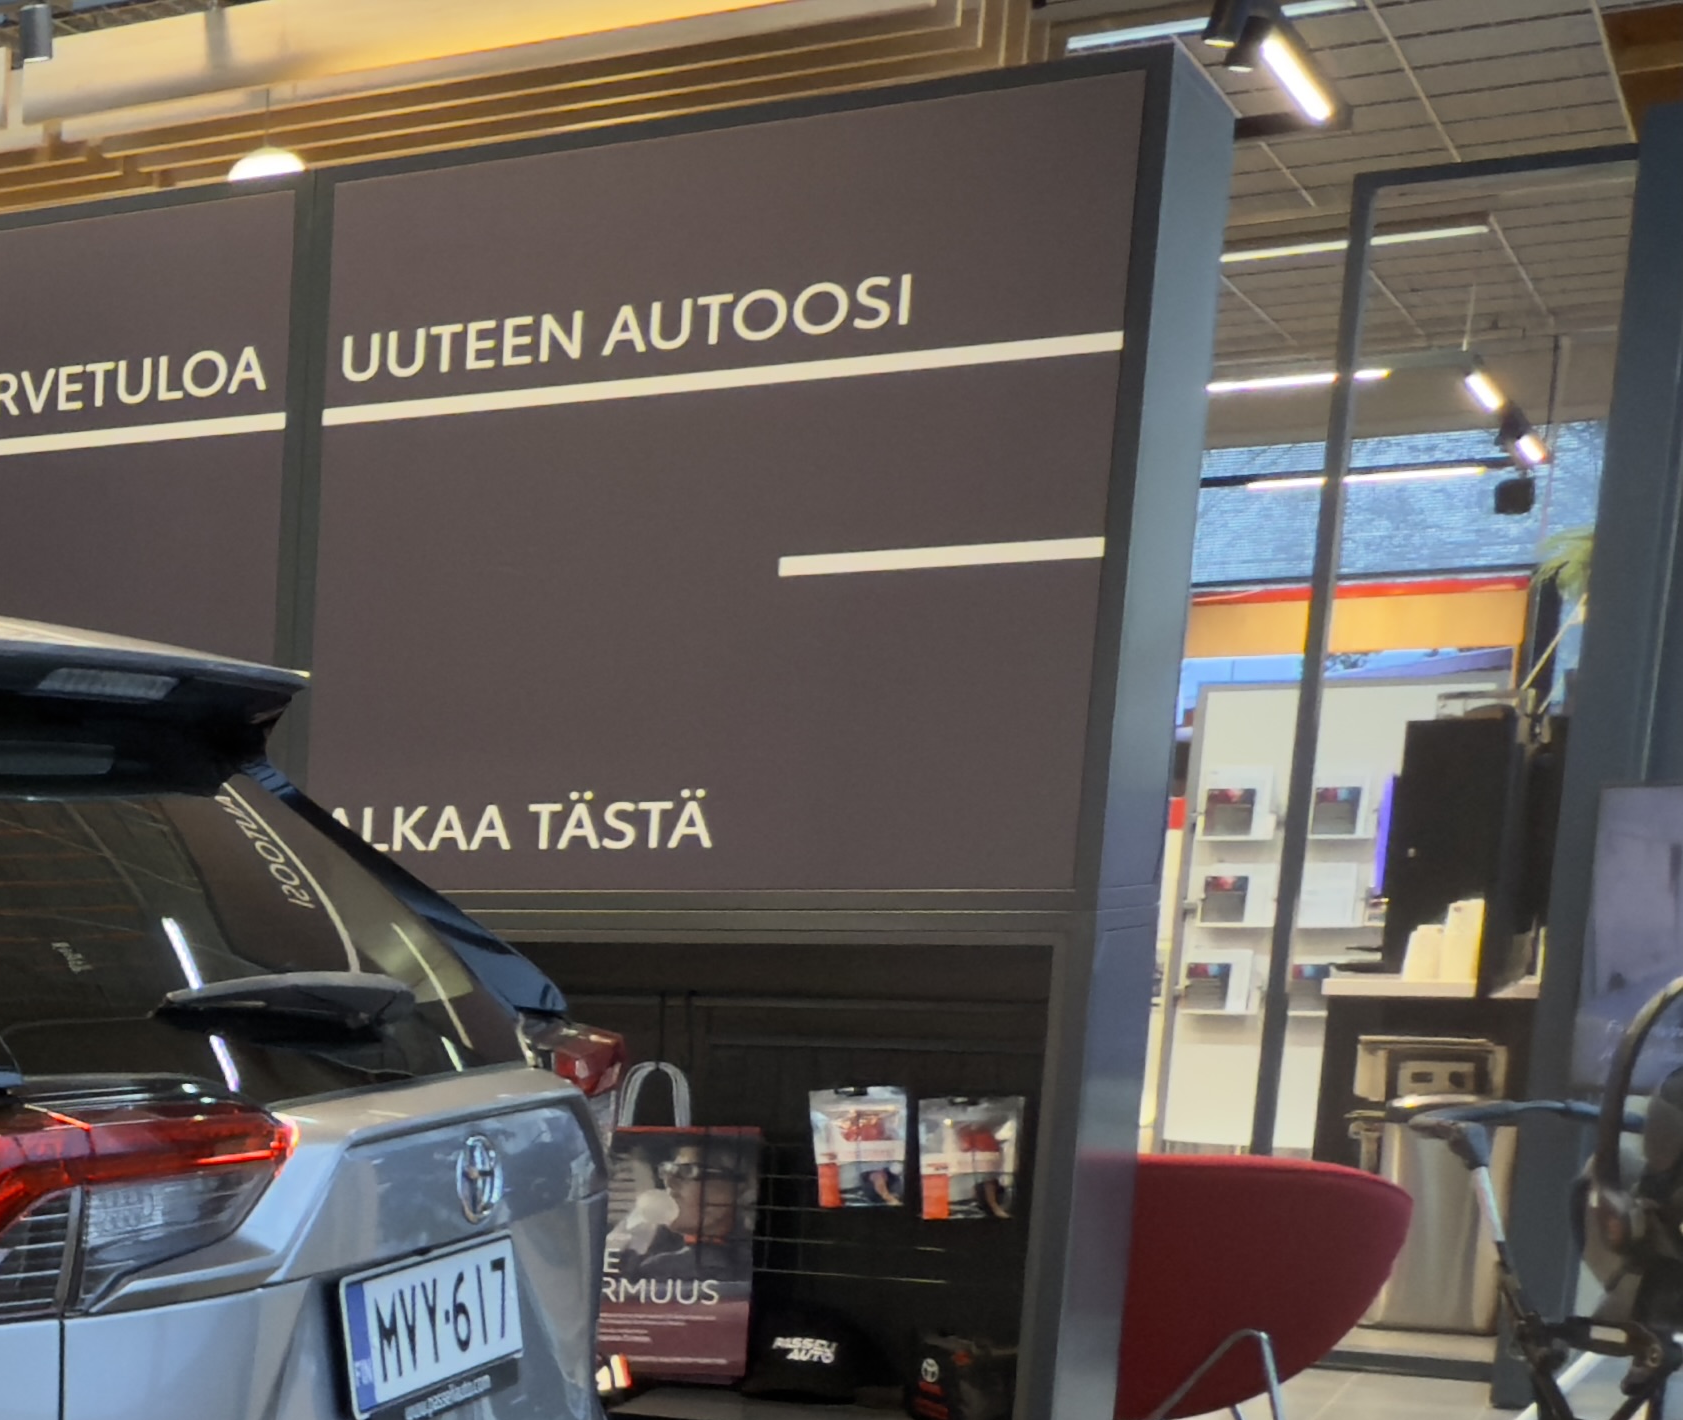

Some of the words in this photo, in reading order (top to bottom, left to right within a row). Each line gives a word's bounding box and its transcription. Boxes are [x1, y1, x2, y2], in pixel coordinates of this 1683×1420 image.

[340, 309, 584, 383] UUTEEN
[600, 272, 913, 359] AUTOOSI
[528, 788, 713, 851] TÄSTÄ
[373, 1255, 508, 1384] MVY-617
[785, 1348, 835, 1364] AUTO
